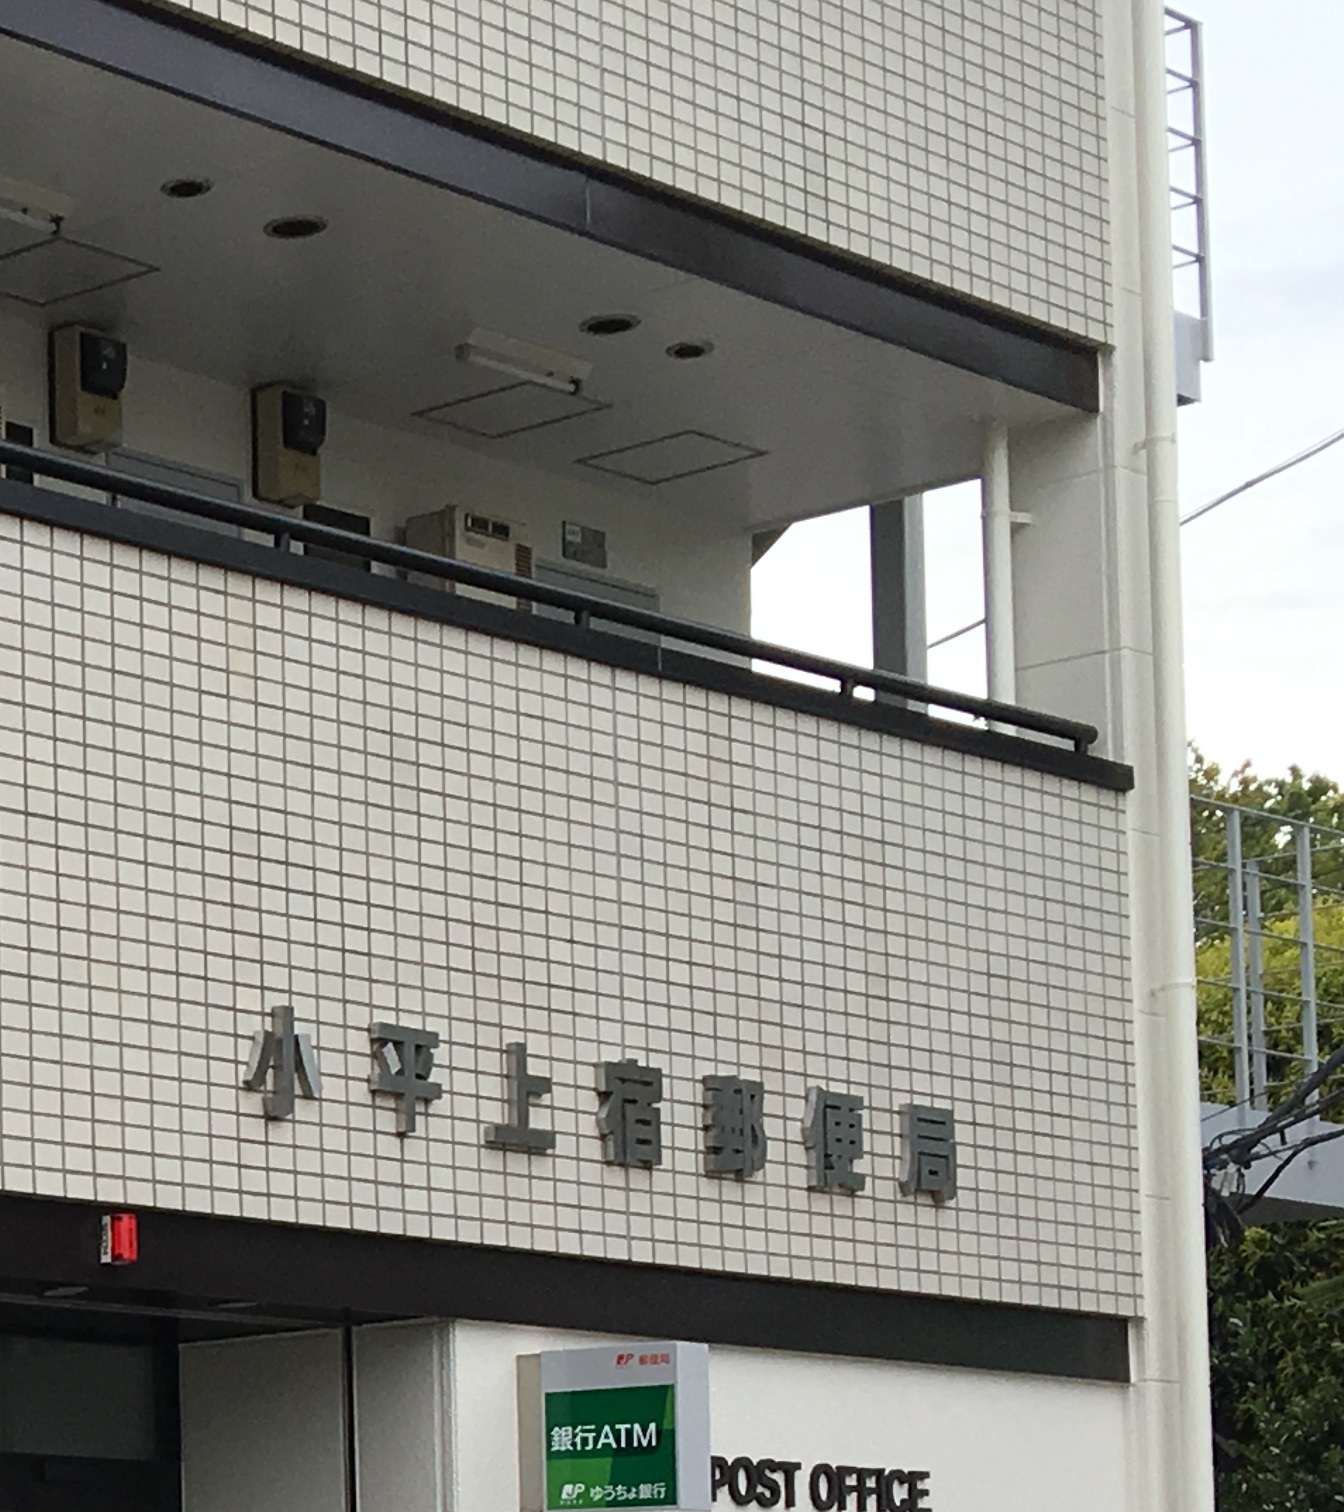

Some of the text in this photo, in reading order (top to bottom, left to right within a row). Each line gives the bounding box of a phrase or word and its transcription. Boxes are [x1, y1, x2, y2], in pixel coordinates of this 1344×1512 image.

[242, 1004, 957, 1202] 小平上宿郵便局
[550, 1422, 657, 1451] 銀行ATM
[589, 1482, 667, 1501] ゆうちょ銀行
[710, 1455, 802, 1508] POST
